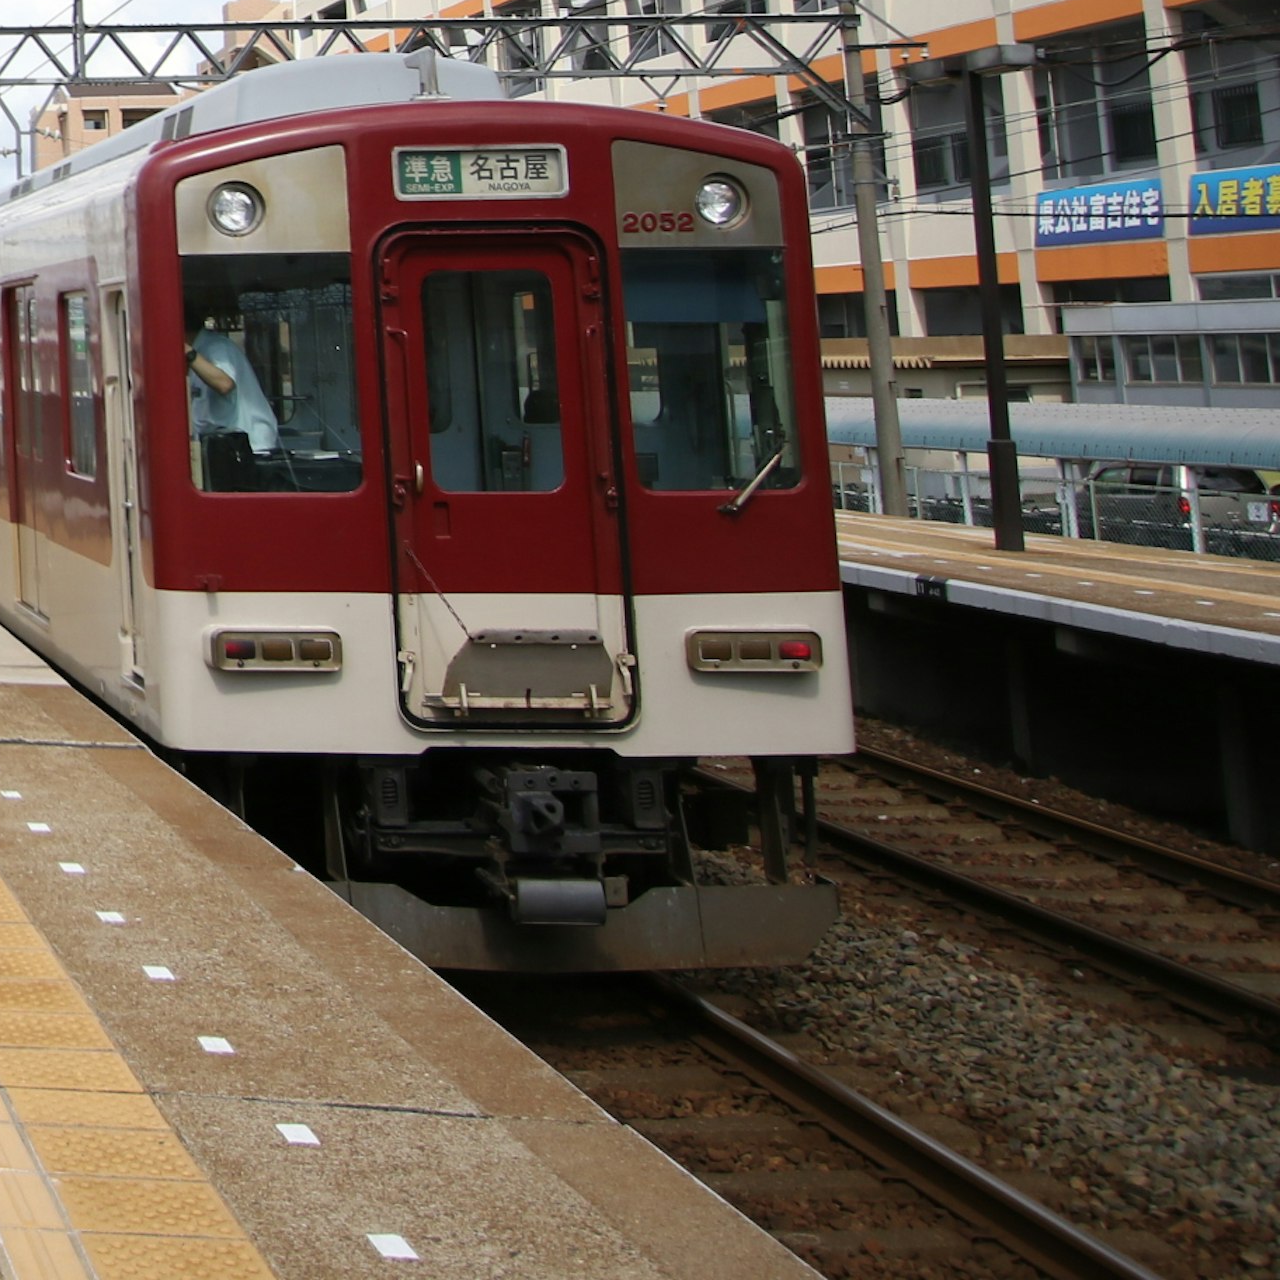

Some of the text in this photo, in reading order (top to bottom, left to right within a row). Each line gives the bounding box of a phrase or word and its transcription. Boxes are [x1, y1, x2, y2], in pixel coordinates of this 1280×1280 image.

[404, 153, 550, 183] 準急 名古屋
[487, 182, 532, 192] NAGOYA
[622, 212, 695, 233] 2052
[1038, 187, 1160, 236] 県公社富吉住宅
